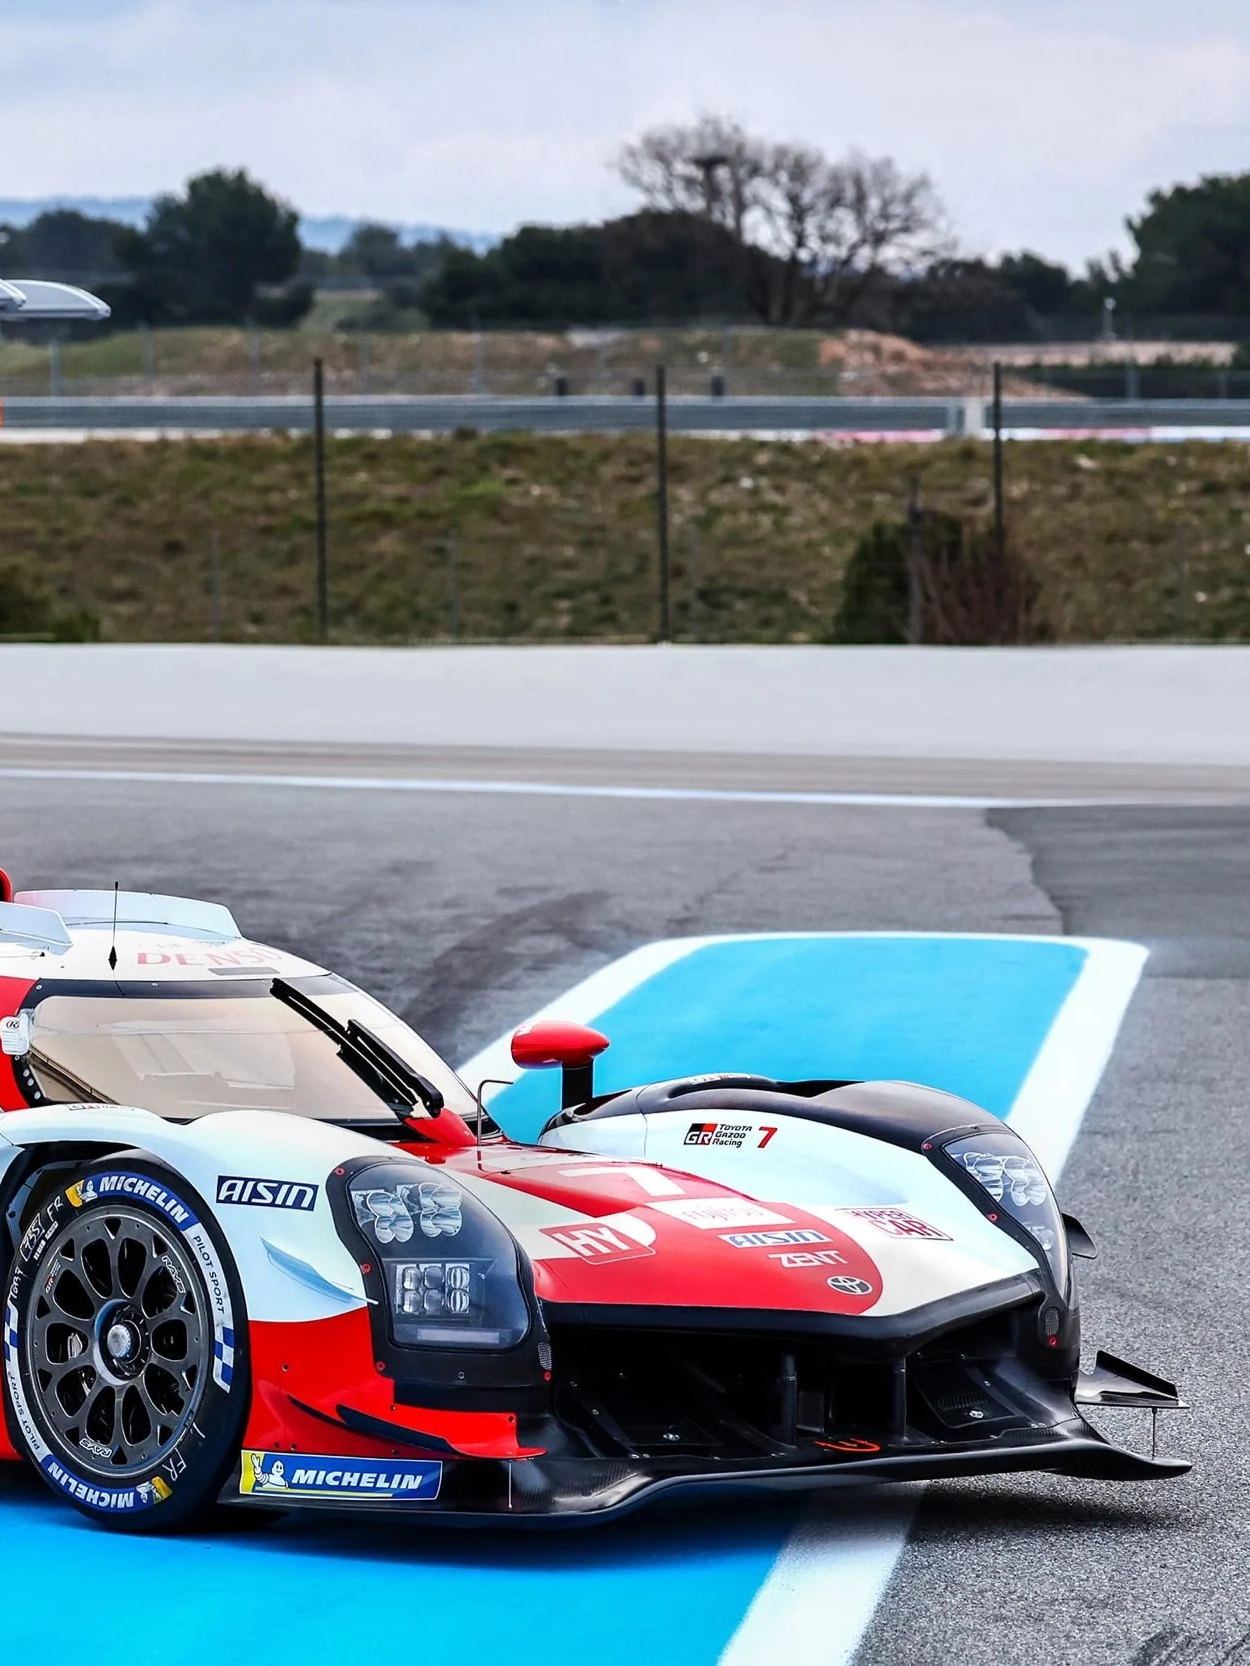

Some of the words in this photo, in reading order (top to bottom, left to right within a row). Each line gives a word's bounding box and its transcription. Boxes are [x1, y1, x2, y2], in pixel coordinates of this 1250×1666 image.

[685, 1131, 712, 1145] GR
[715, 1131, 746, 1139] GAZOO
[720, 1124, 752, 1132] TOYOTA
[757, 1126, 778, 1148] 7
[712, 1139, 742, 1148] Racing
[100, 1176, 190, 1224] MICHELIN
[218, 1179, 314, 1208] AISIN
[729, 1230, 825, 1247] AISIN
[868, 1219, 943, 1236] CAR
[551, 1227, 630, 1257] HY
[766, 1250, 848, 1268] ZENT
[161, 1254, 185, 1294] RAYS
[193, 1235, 213, 1269] PILOT
[209, 1272, 225, 1314] SPORT
[11, 1375, 25, 1417] SPORT
[21, 1419, 40, 1450] PILOT
[48, 1461, 134, 1509] MICHELIN
[291, 1469, 422, 1490] MICHELIN
